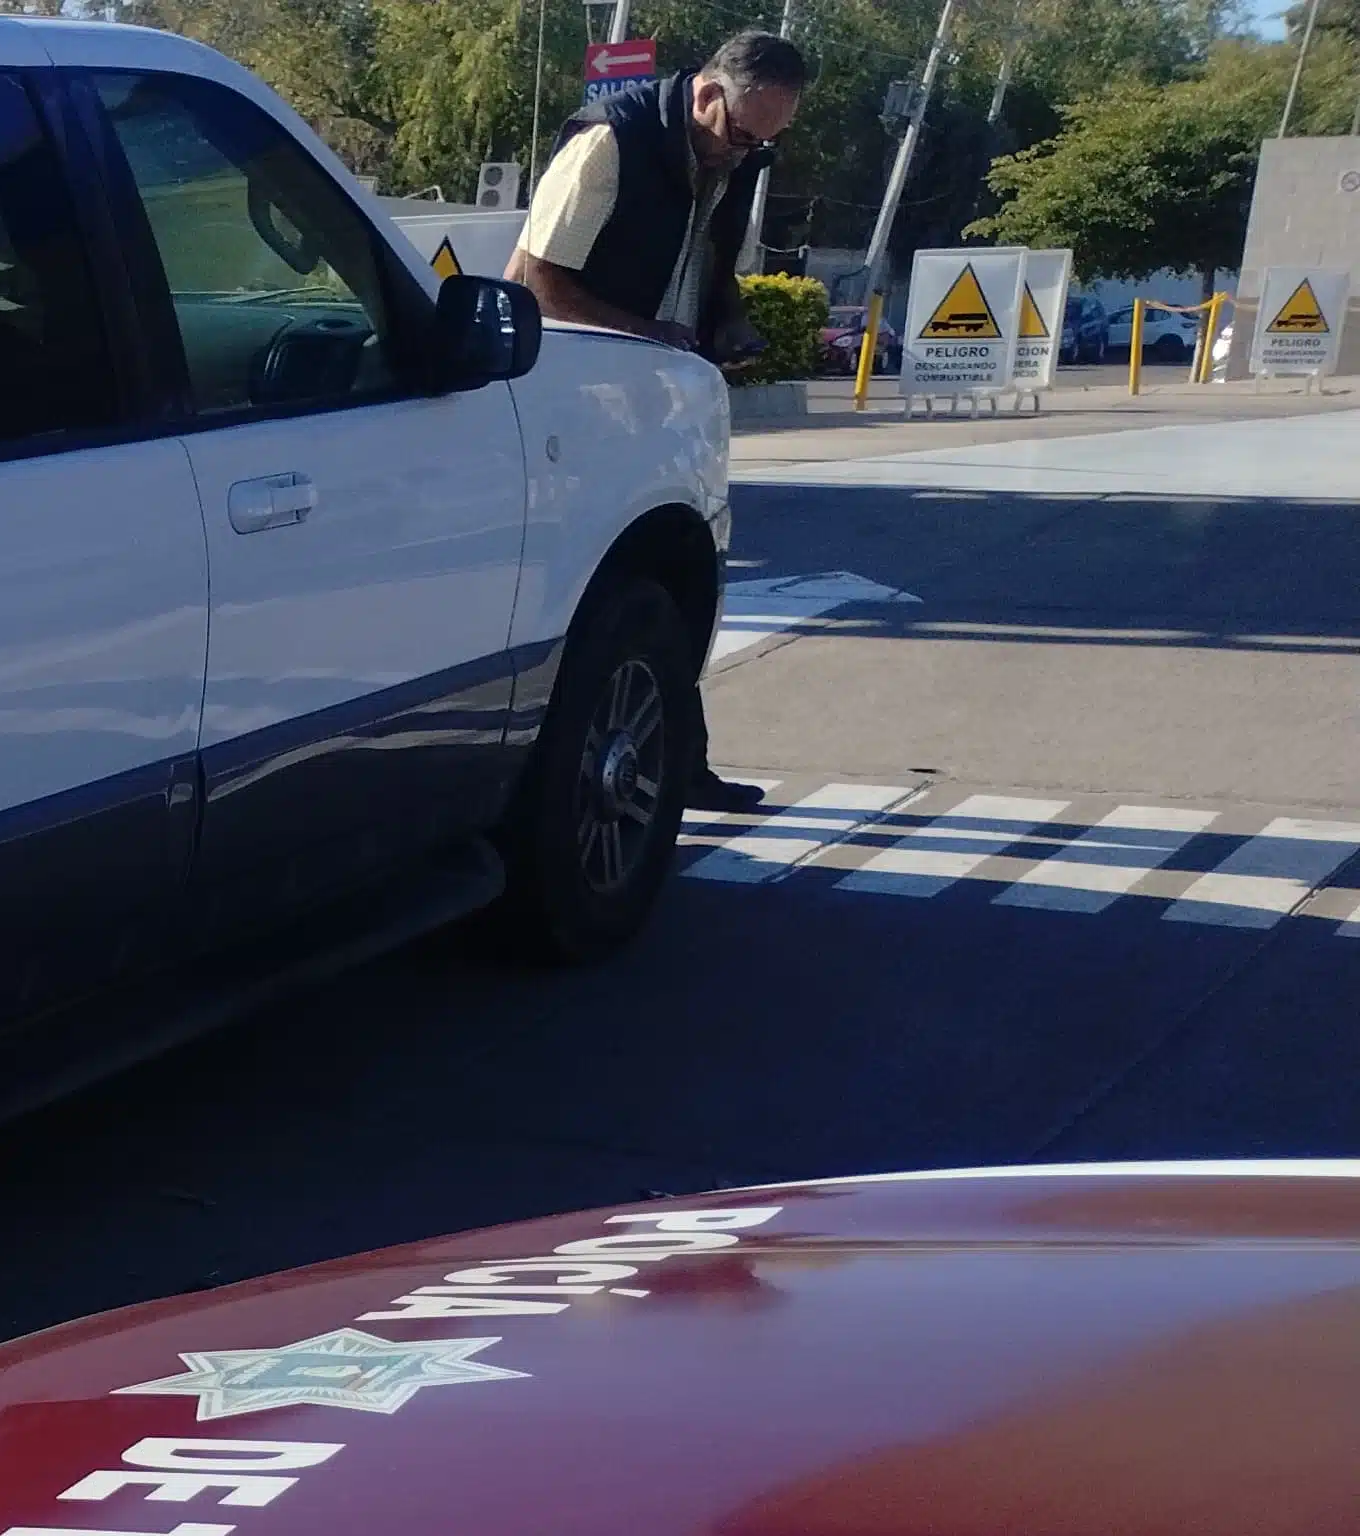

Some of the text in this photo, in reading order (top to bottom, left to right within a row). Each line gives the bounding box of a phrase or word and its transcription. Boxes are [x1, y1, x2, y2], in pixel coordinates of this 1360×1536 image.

[588, 79, 654, 105] SALID
[925, 346, 990, 358] PELIGRO
[1016, 346, 1050, 356] CION
[914, 362, 997, 371] DESCARGANDO
[914, 373, 993, 382] COMBUSTIBLE
[354, 1206, 784, 1321] POLICÍA
[55, 1437, 347, 1507] DE
